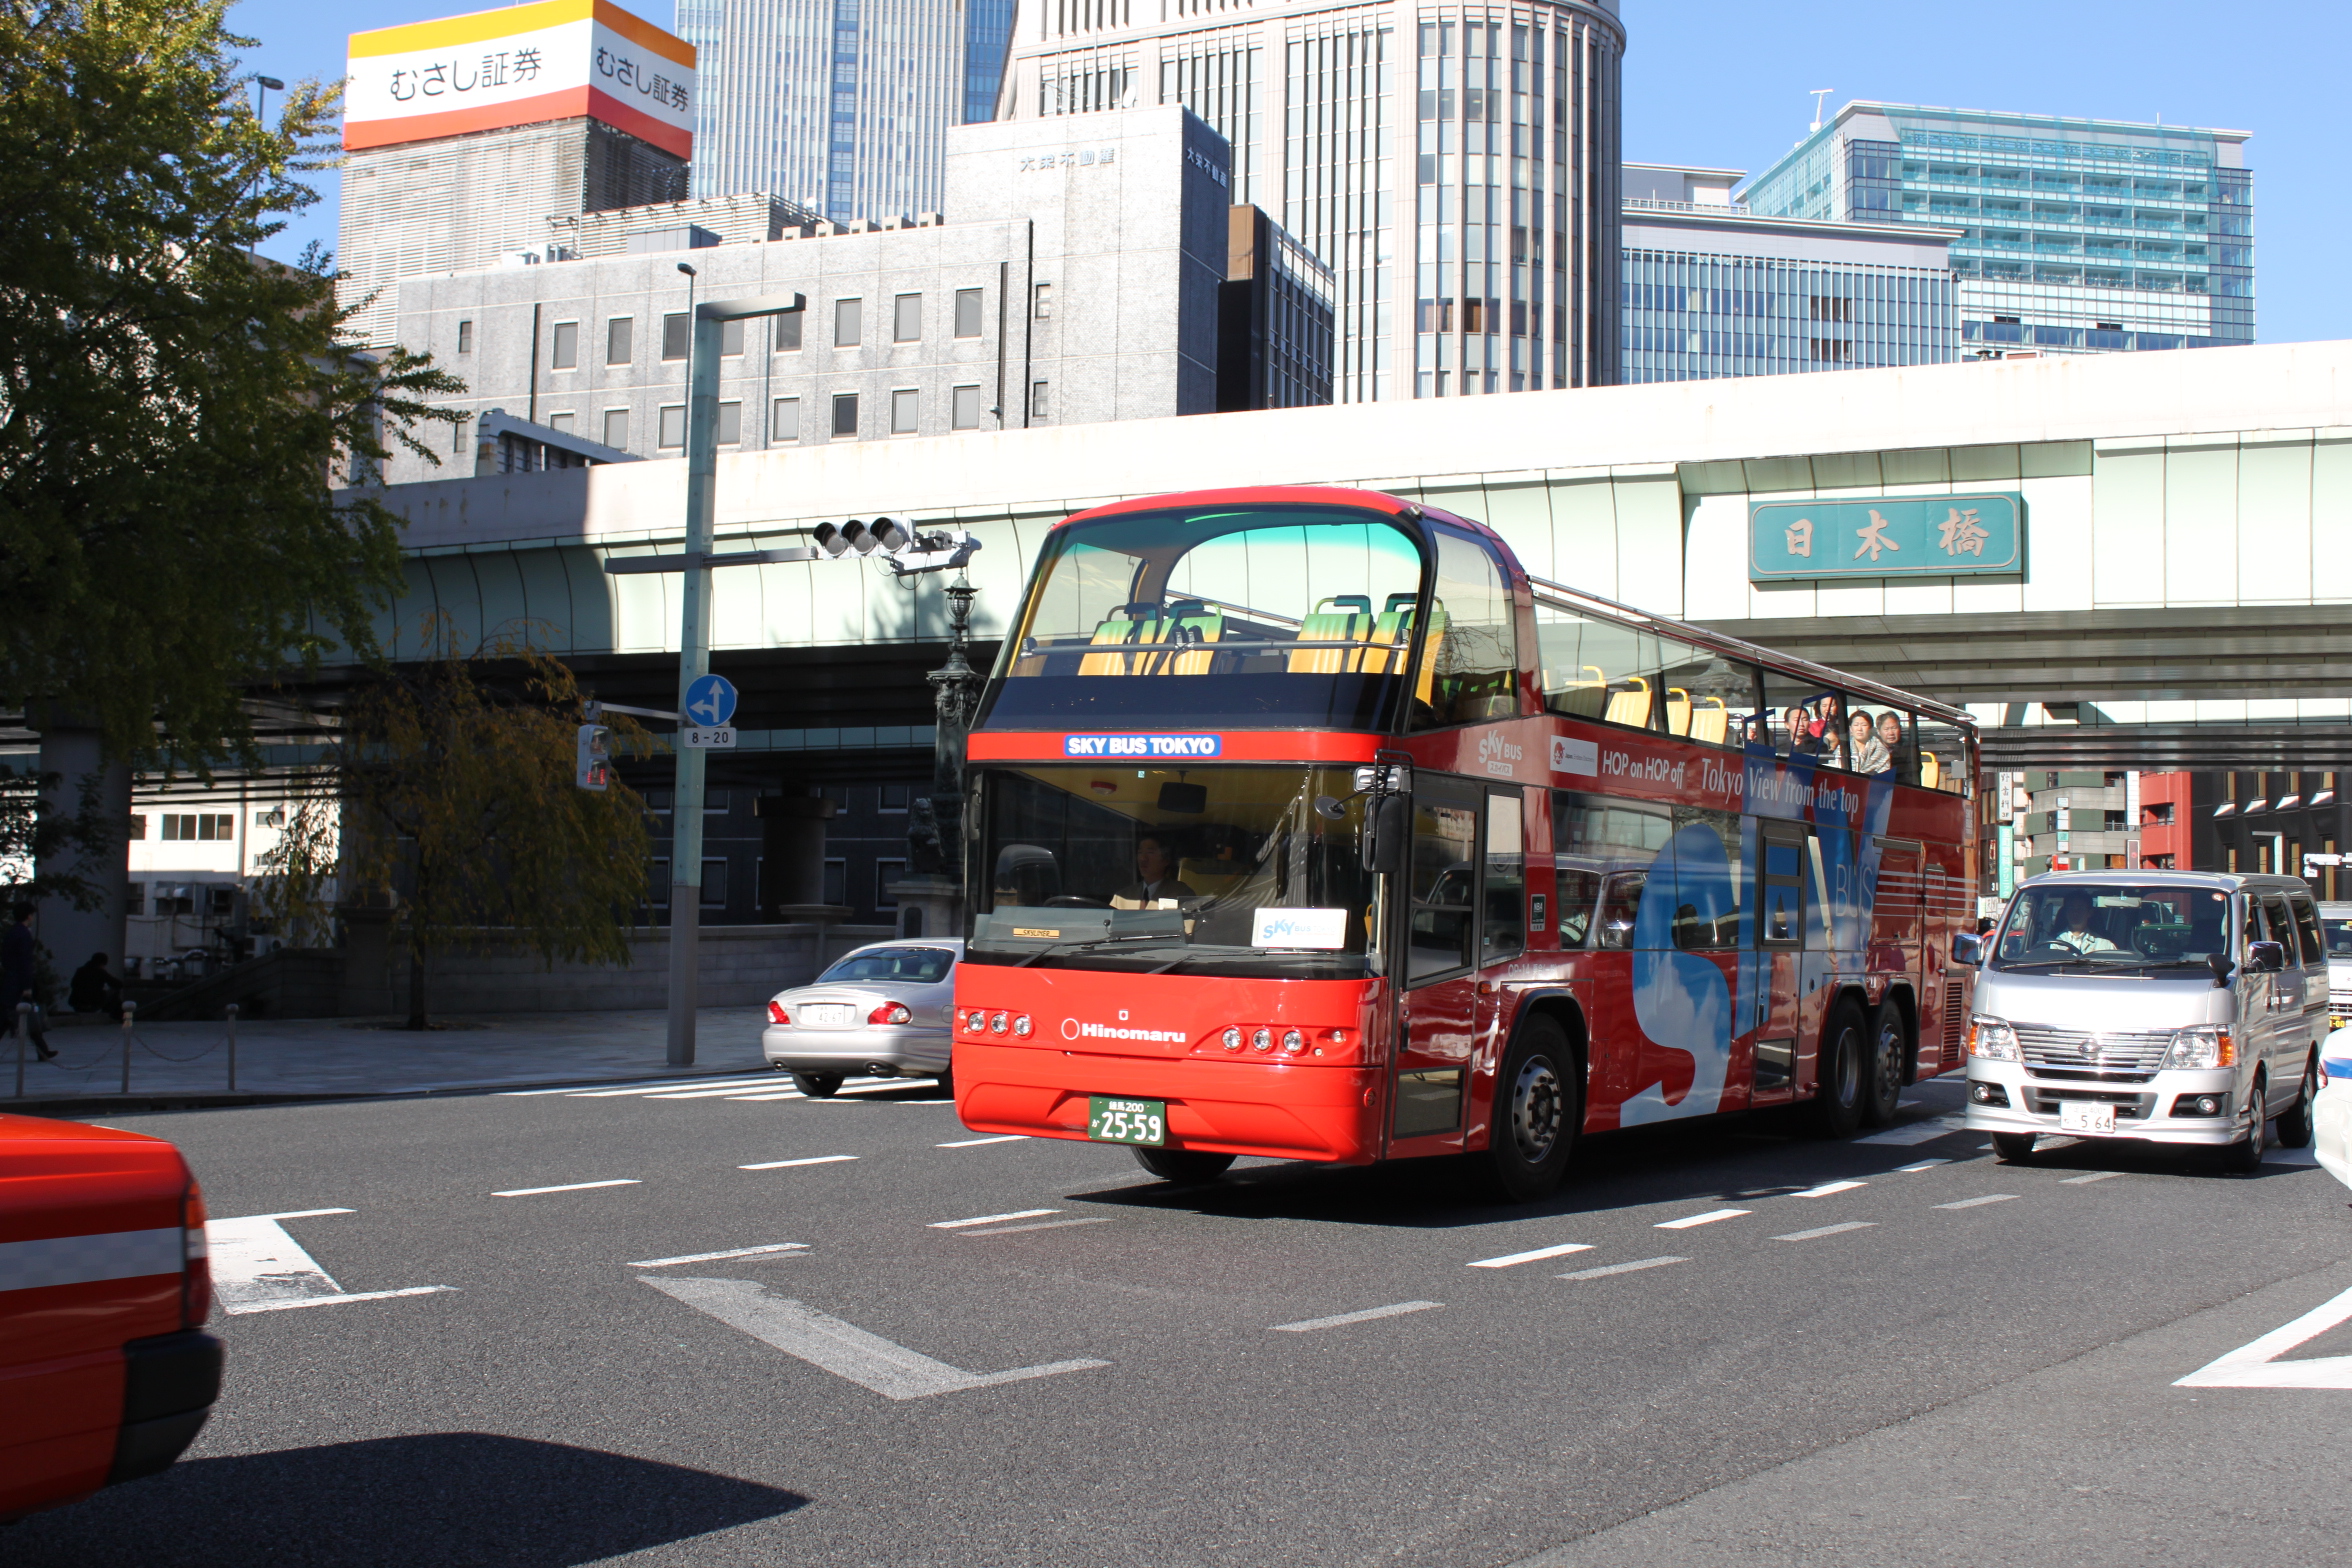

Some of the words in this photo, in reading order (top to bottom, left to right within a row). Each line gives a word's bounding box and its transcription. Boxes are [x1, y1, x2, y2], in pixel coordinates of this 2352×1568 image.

[390, 47, 542, 102] むさし証券
[596, 46, 690, 112] むさし証券
[1020, 147, 1115, 173] 大栄不動産
[1187, 146, 1228, 188] 大栄不動産
[1784, 508, 1990, 562] 日本橋
[1068, 737, 1107, 754] SKY
[1109, 737, 1148, 754] BUS
[1150, 737, 1215, 755] TOKYO
[1478, 729, 1505, 764] SKY
[1504, 743, 1523, 760] BUS
[1602, 750, 1628, 775] HOP
[1630, 761, 1642, 778] on
[1645, 757, 1670, 782] HOP
[1671, 762, 1685, 789] off
[1702, 758, 1744, 804] Tokyo
[1749, 766, 1781, 801] View
[1785, 772, 1815, 807] from
[1818, 778, 1837, 811] the
[1840, 785, 1859, 822] top
[1836, 864, 1874, 918] BUS
[1263, 919, 1295, 938] SKY
[1082, 1023, 1186, 1043] Hinomaru
[1101, 1111, 1161, 1142] 25-59
